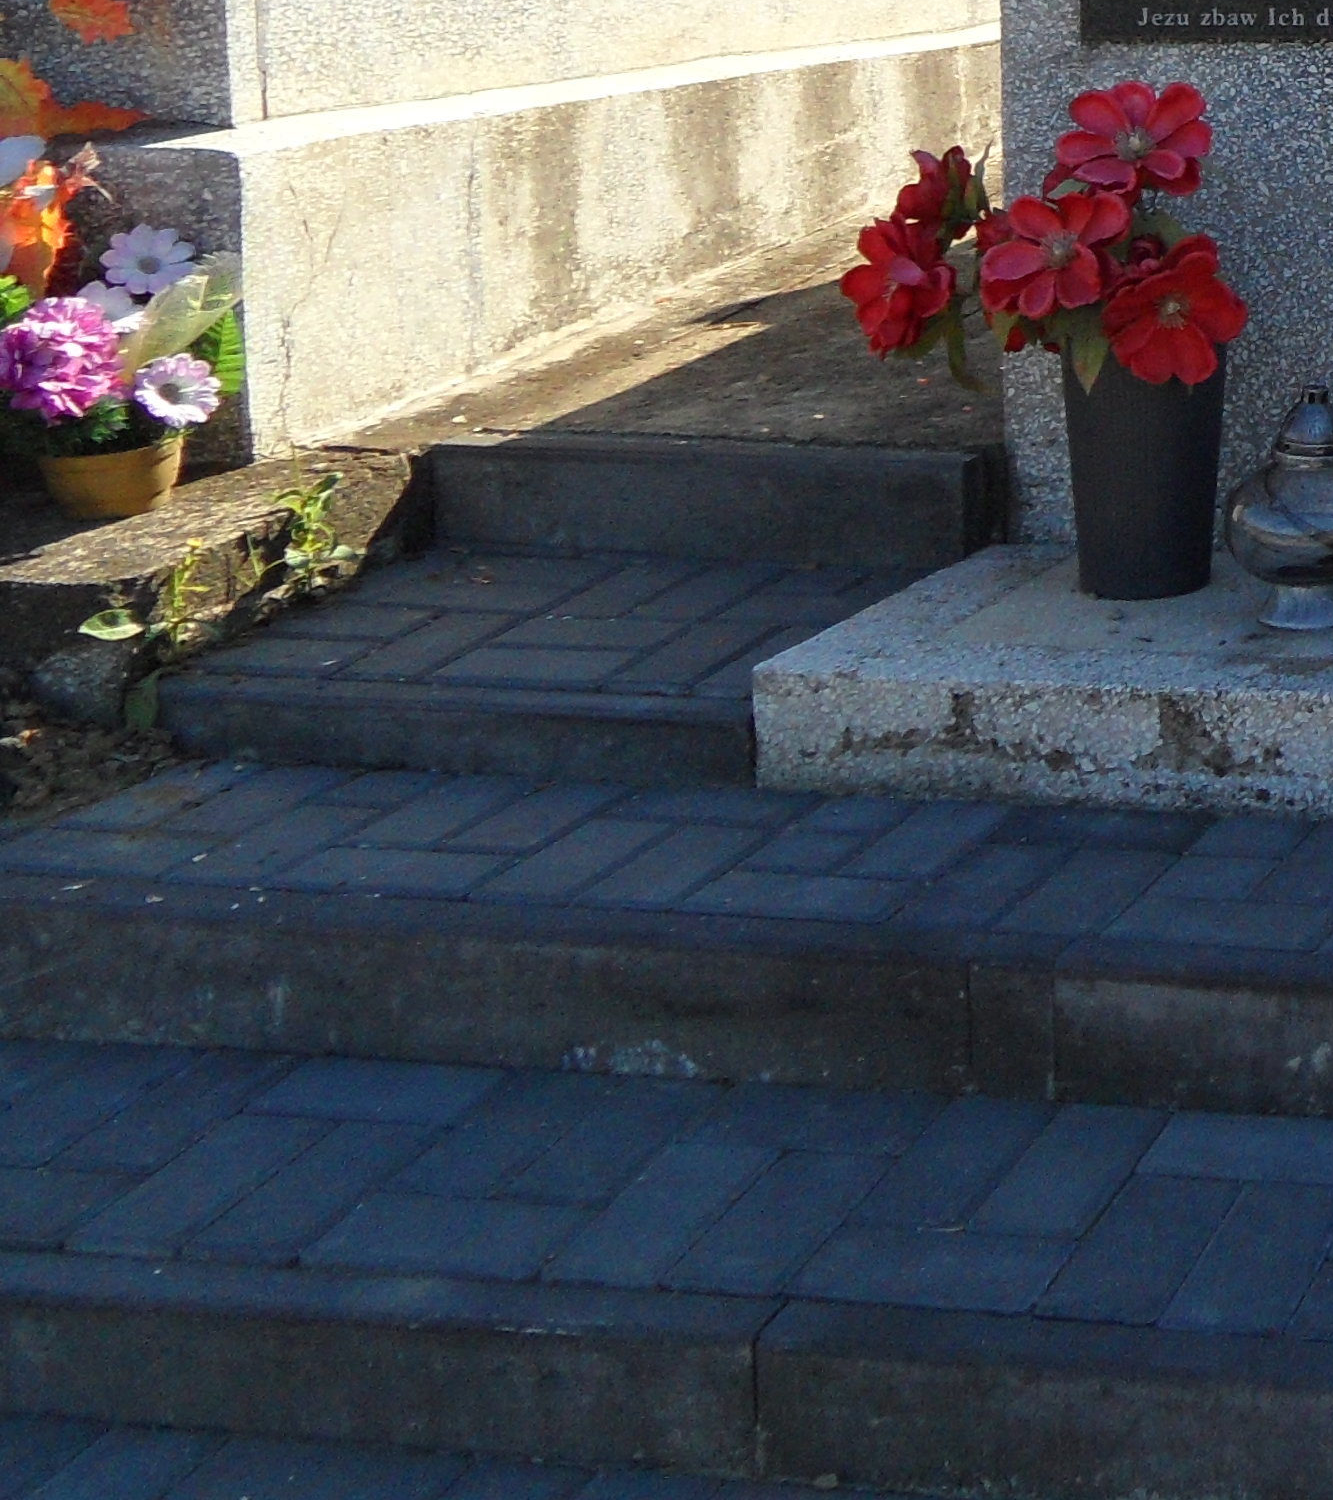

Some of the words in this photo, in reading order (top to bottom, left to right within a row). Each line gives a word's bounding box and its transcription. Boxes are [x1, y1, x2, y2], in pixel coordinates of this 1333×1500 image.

[1137, 7, 1189, 27] Jezu
[1200, 7, 1258, 27] zbaw
[1268, 7, 1304, 27] Ich
